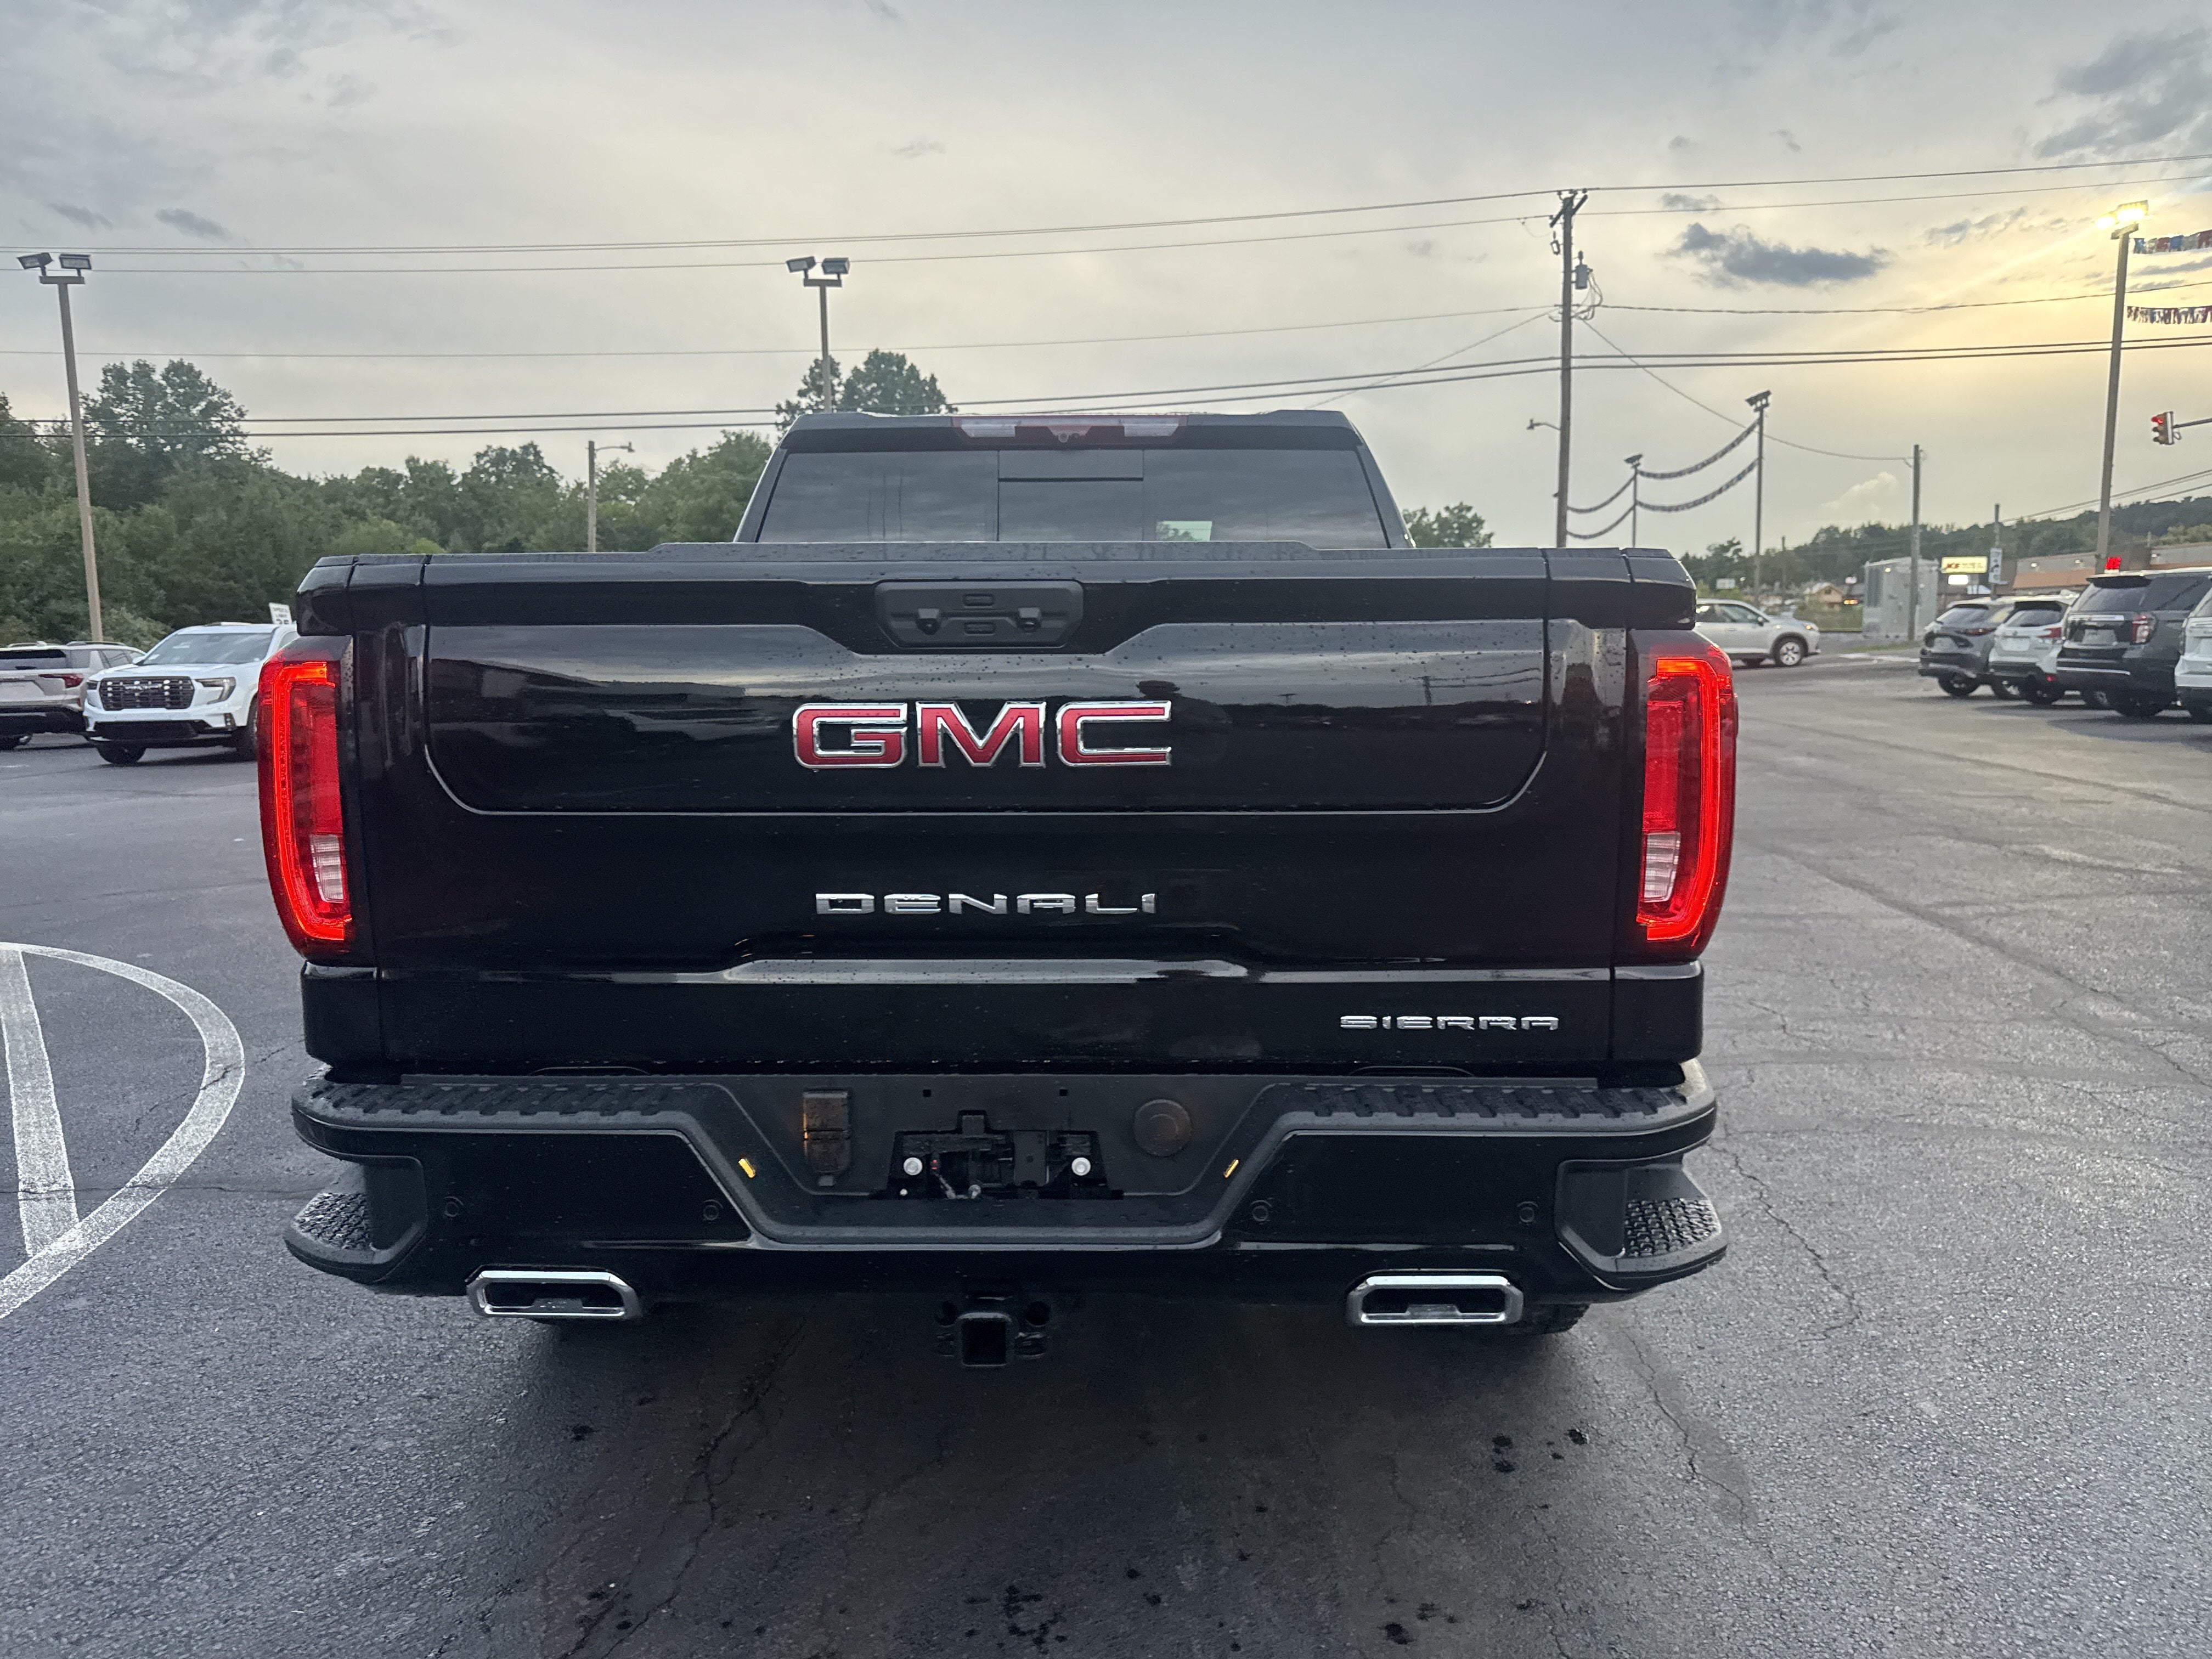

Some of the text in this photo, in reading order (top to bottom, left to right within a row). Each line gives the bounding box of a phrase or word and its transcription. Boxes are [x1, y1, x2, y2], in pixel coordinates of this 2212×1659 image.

[793, 701, 1172, 768] GMC
[816, 893, 1156, 915] DENALI
[1340, 1015, 1559, 1030] SIERRA
